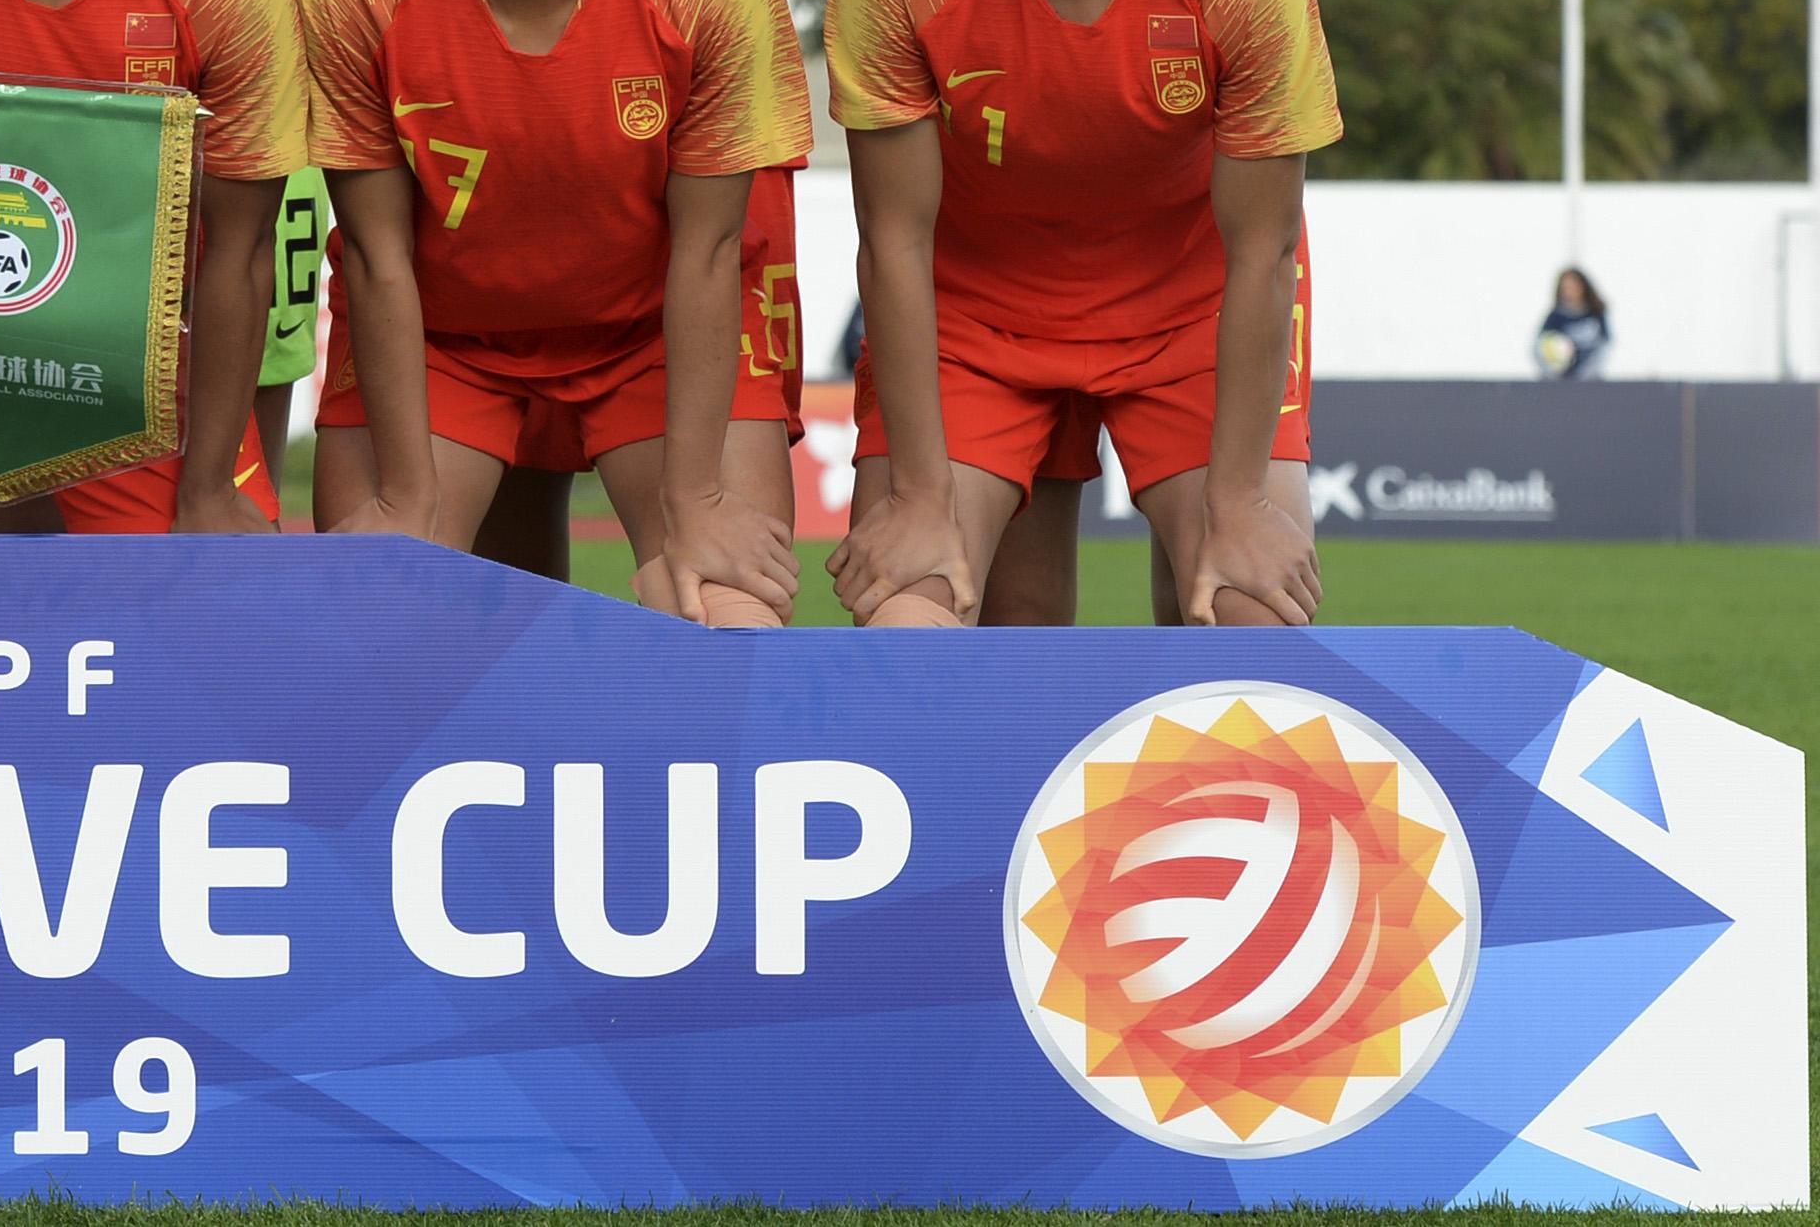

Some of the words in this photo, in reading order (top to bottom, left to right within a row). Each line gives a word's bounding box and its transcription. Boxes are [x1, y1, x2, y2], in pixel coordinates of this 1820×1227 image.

[130, 60, 171, 73] CFA
[1156, 60, 1197, 74] CFA
[617, 79, 659, 93] CFA
[399, 137, 488, 229] 7
[271, 198, 318, 308] 2
[18, 386, 104, 406] ASSOCIATION
[1366, 465, 1556, 512] CaixaBank
[391, 760, 912, 978] CUP
